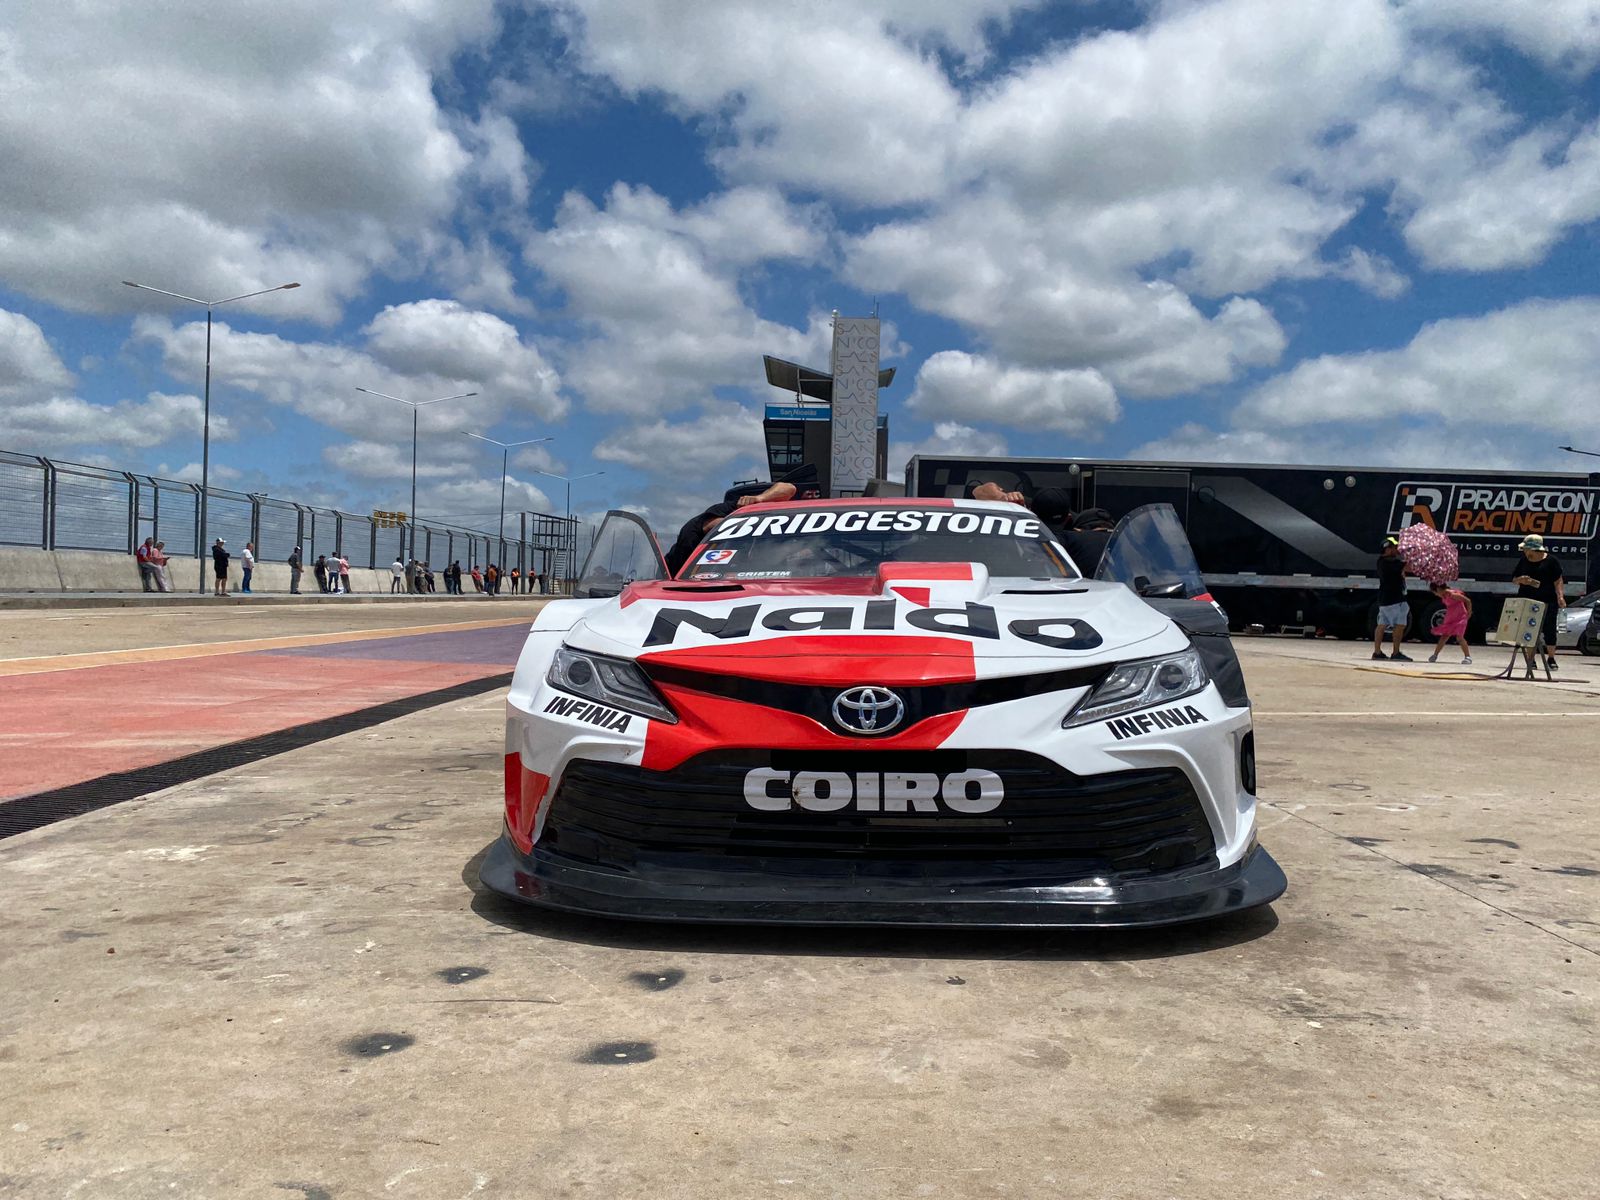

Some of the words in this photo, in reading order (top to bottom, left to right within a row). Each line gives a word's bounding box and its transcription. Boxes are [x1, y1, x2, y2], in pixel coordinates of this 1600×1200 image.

[1457, 489, 1595, 513] PRADECON
[709, 511, 1041, 541] BRIDGESTONE
[1453, 511, 1547, 532] RACING
[642, 599, 1103, 650] Naldo
[543, 696, 632, 734] INFINIA
[1105, 705, 1209, 741] INFINIA
[743, 767, 1004, 813] COIRO
